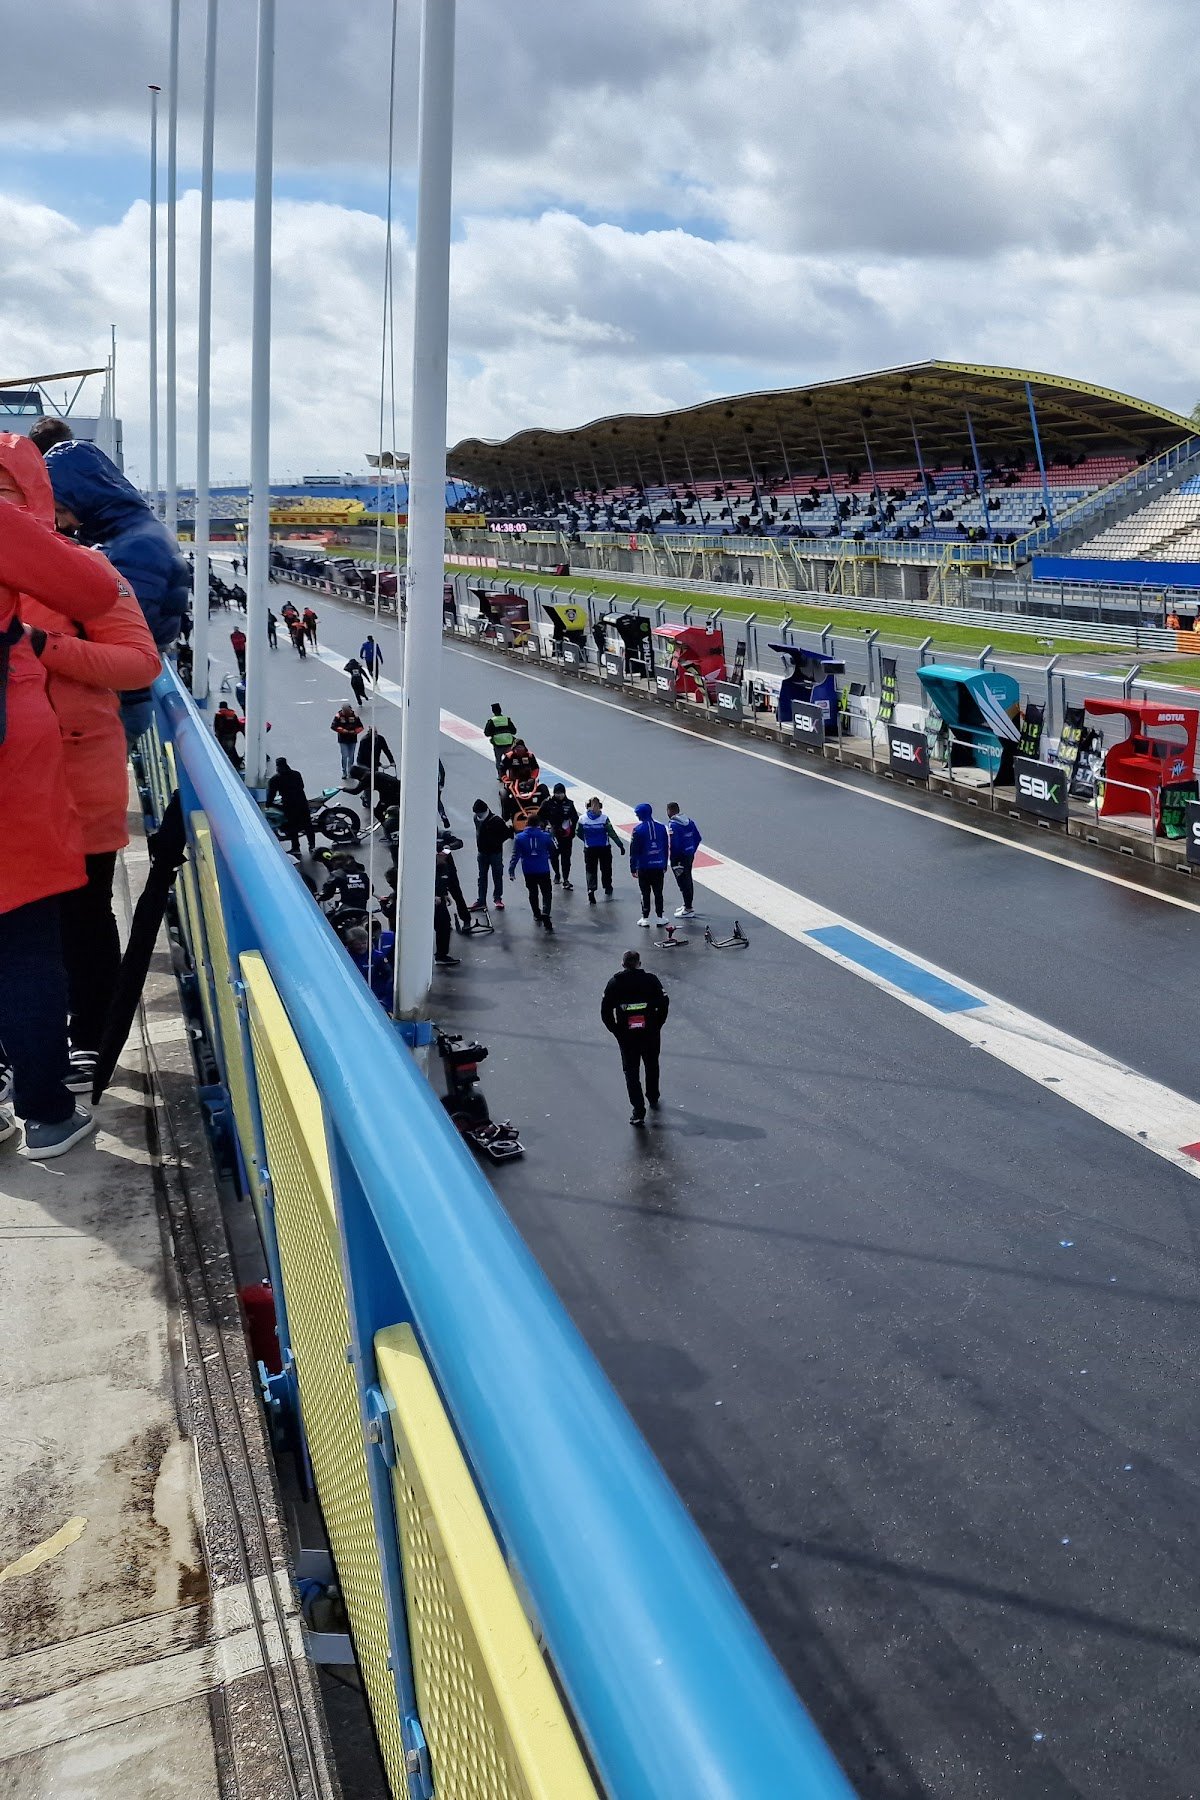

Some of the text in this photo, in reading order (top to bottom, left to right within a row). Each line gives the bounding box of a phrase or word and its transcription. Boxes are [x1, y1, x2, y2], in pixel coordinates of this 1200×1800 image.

[270, 516, 349, 524] IRELLI
[489, 522, 528, 533] 14:38:03
[718, 692, 739, 711] SBK
[794, 713, 819, 734] SBK
[1157, 713, 1186, 722] MOTUL
[891, 739, 923, 764] SBK
[1019, 773, 1060, 804] SBK
